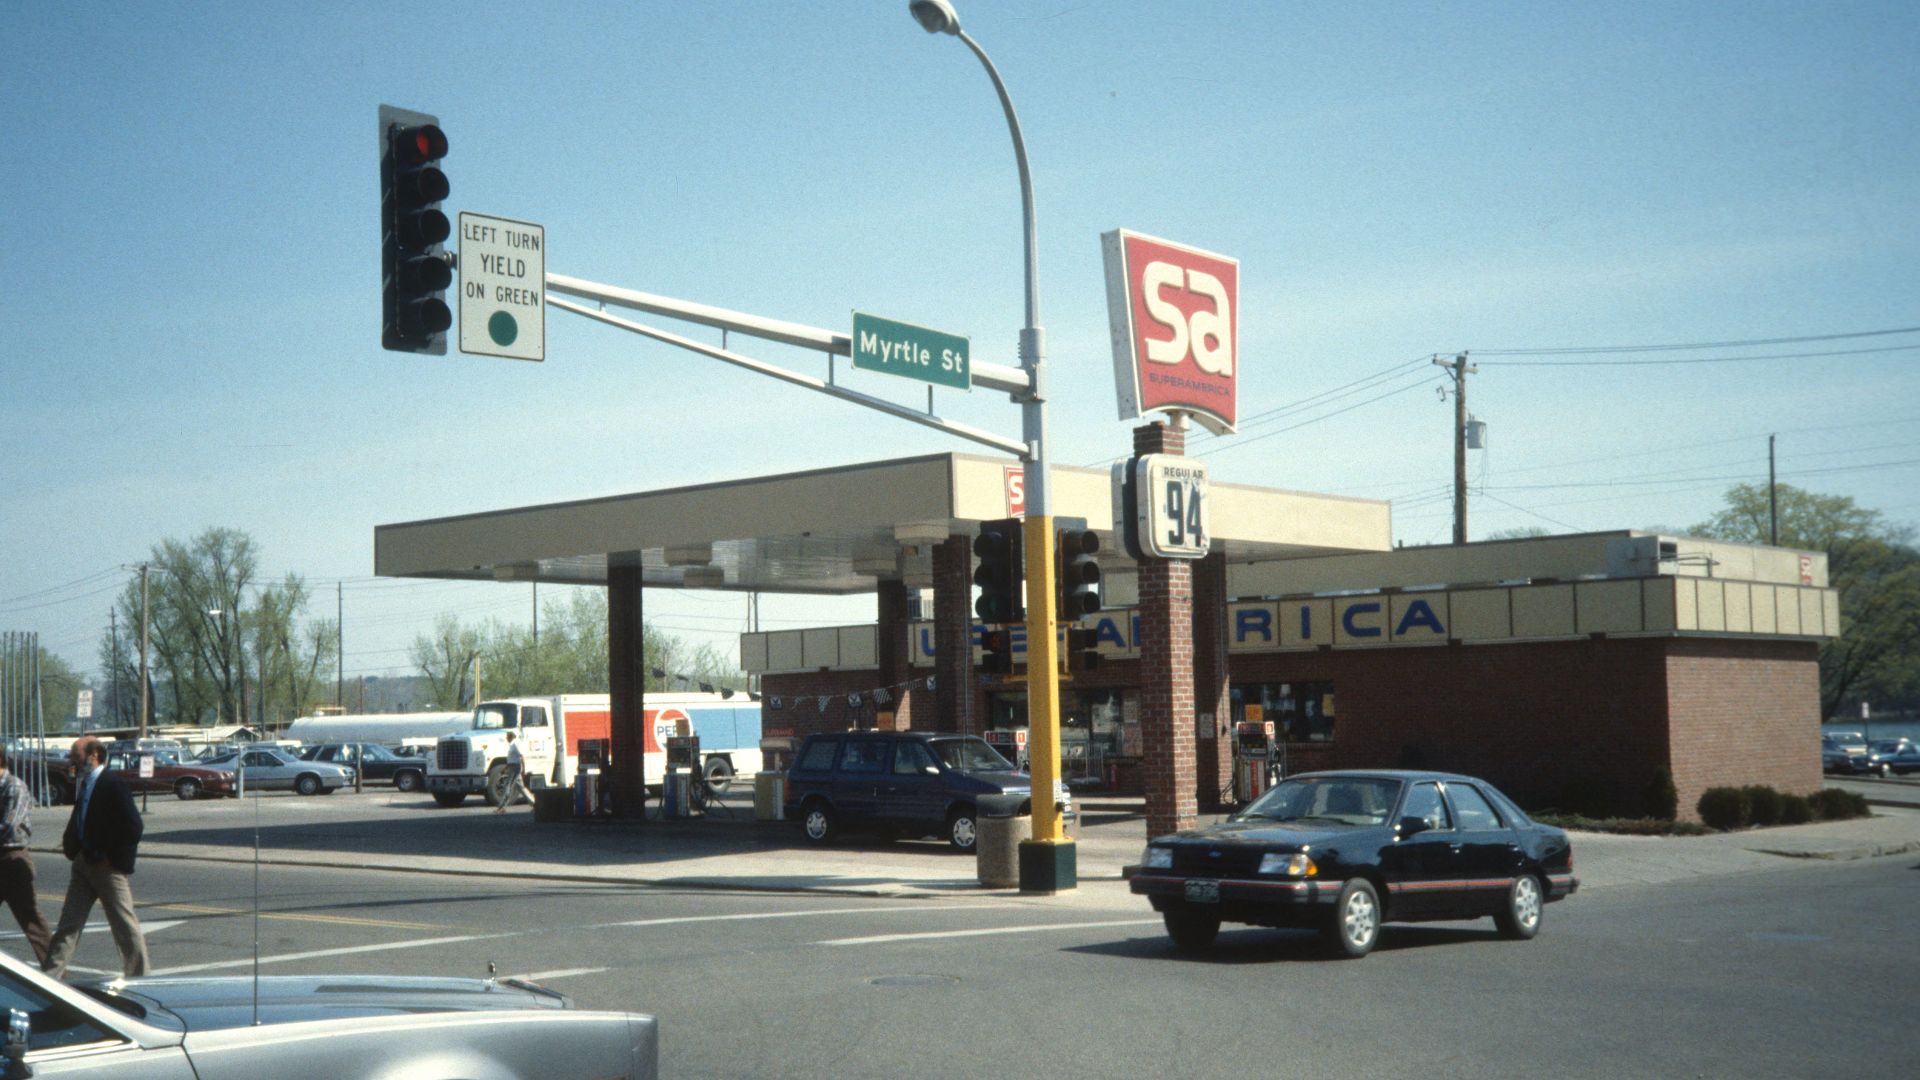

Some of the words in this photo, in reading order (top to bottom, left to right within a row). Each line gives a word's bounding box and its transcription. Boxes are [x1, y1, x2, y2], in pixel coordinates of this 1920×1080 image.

[464, 223, 496, 243] LEFT
[505, 229, 539, 251] TURN
[481, 253, 526, 278] YIELD
[466, 281, 485, 299] ON
[496, 285, 539, 307] GREEN
[860, 330, 930, 366] Myrtle
[941, 348, 963, 373] St
[1149, 372, 1231, 397] SUPERAMERICA
[1167, 480, 1203, 548] 94
